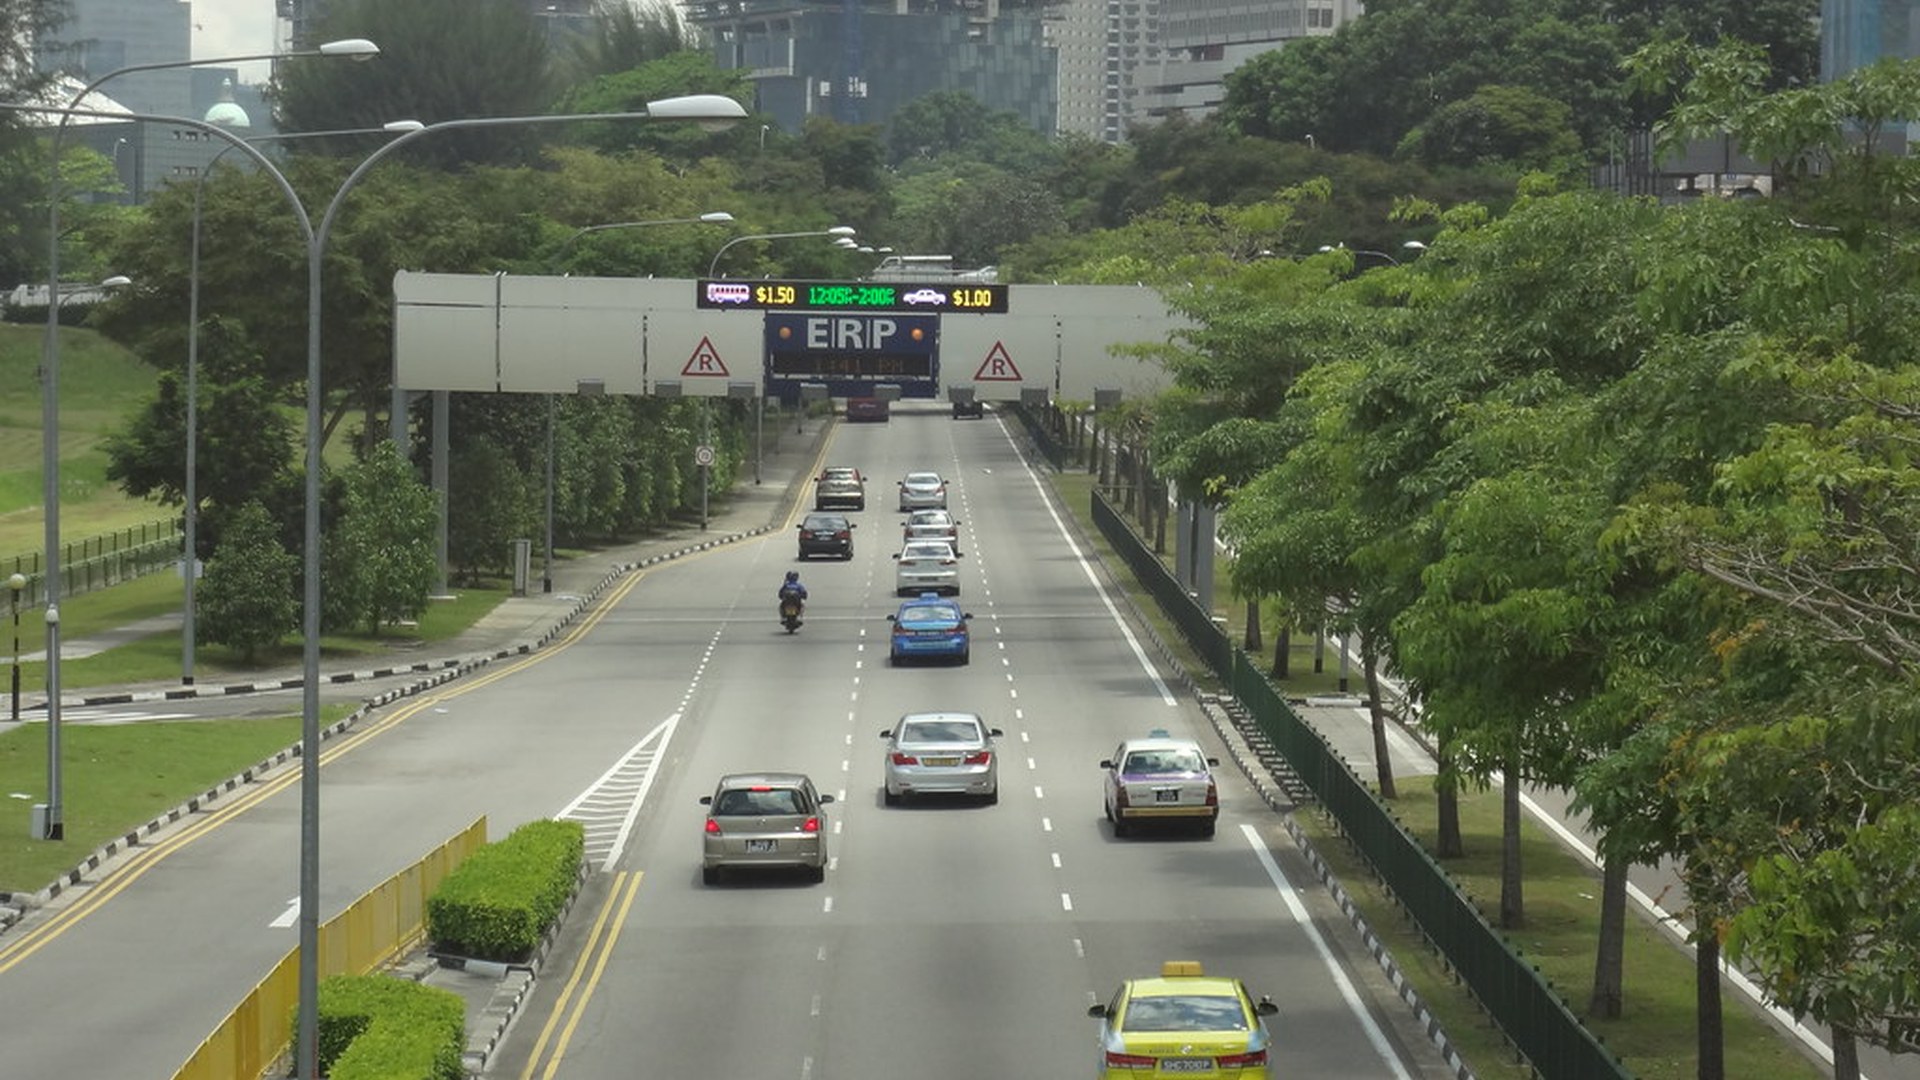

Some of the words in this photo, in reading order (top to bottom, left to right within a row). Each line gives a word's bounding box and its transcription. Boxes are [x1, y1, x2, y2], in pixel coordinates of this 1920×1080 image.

[756, 286, 795, 304] $1.50
[952, 289, 991, 307] $1.00
[700, 354, 712, 371] R
[992, 359, 1005, 375] R
